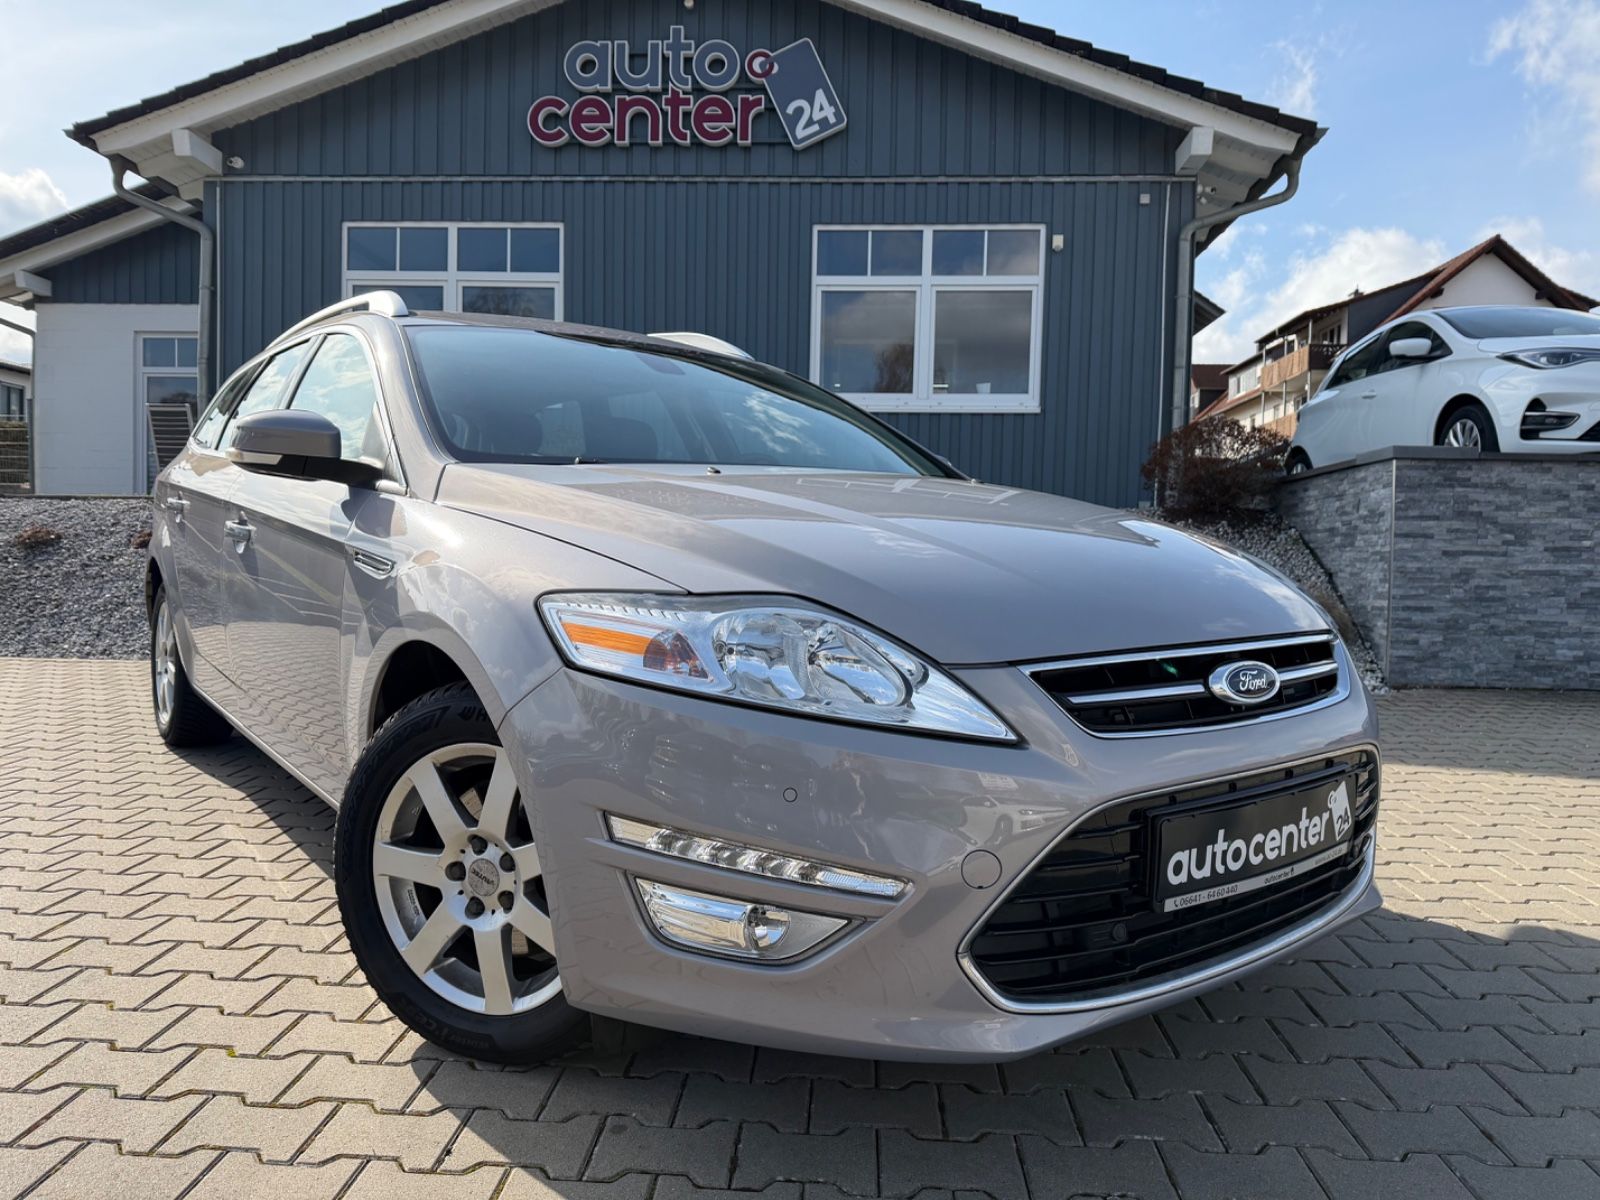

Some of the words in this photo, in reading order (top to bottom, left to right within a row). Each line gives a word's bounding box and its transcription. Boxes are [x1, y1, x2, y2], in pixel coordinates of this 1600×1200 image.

[564, 25, 740, 91] auto
[527, 86, 764, 147] center
[786, 88, 836, 139] 24
[1239, 670, 1268, 691] Ford
[1167, 807, 1330, 886] autocenter
[1336, 811, 1350, 836] 24
